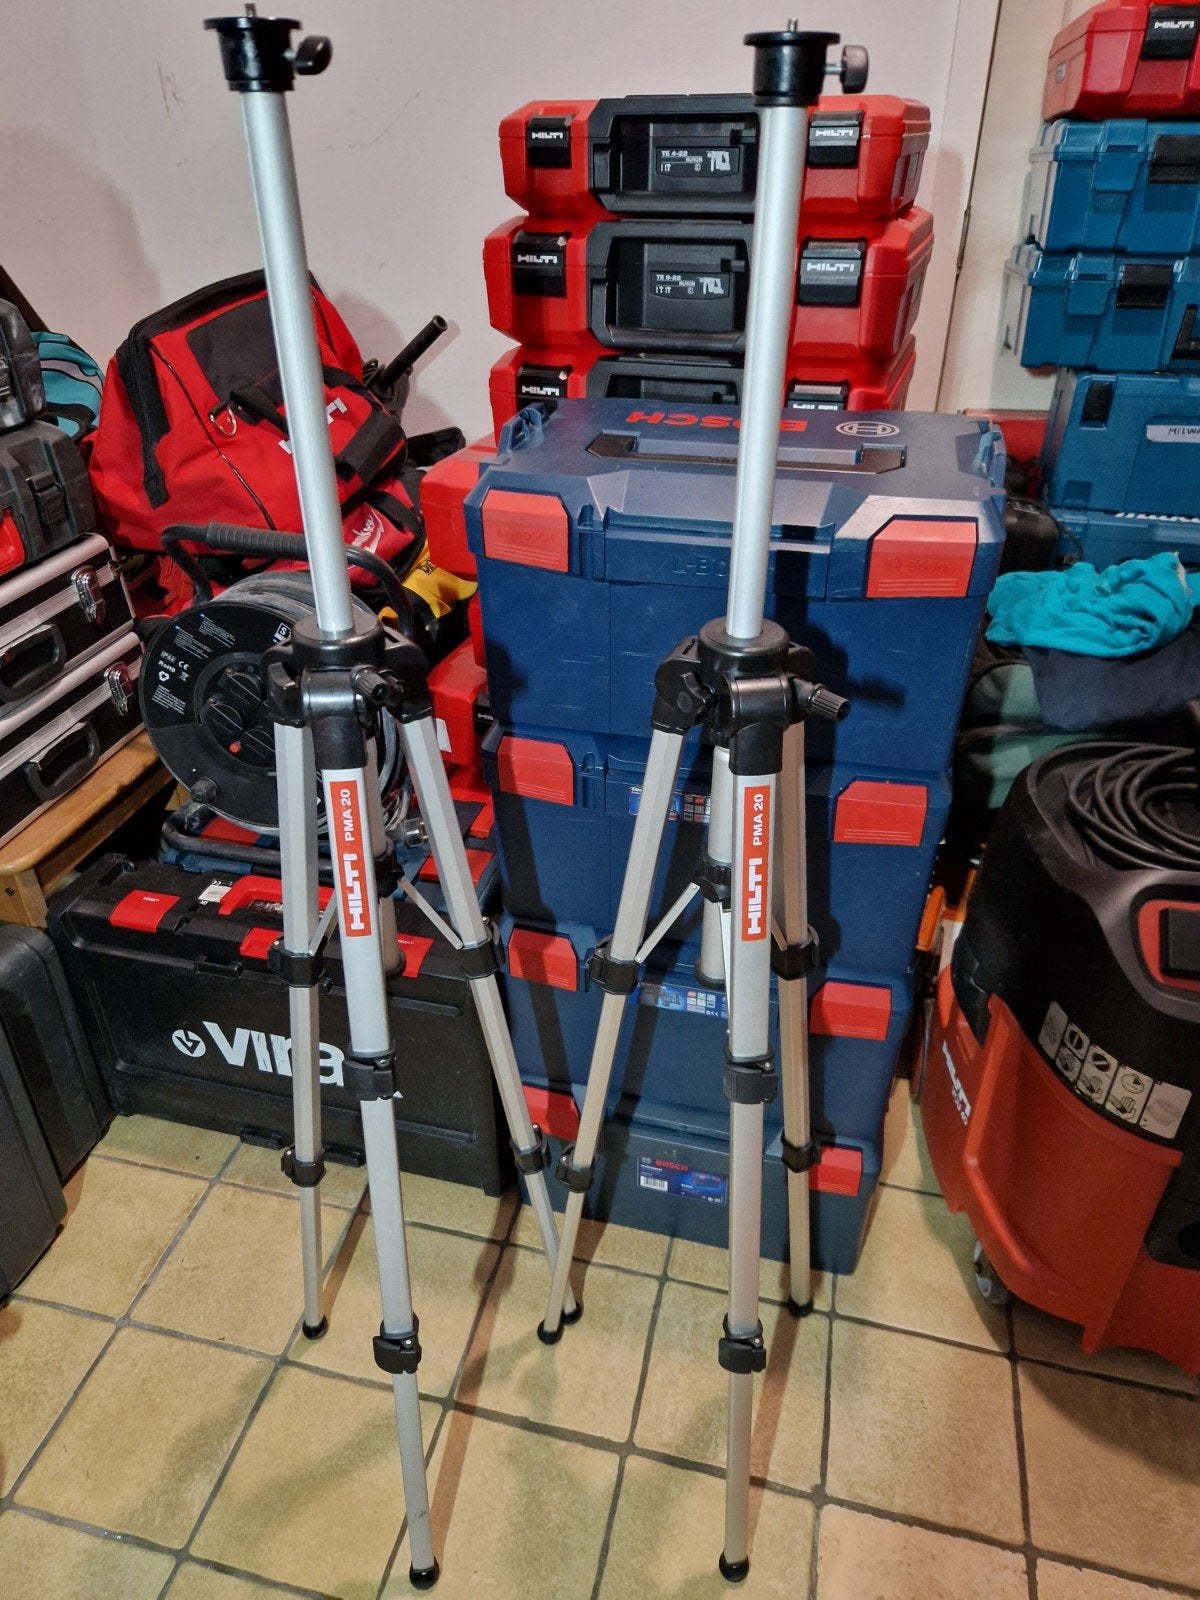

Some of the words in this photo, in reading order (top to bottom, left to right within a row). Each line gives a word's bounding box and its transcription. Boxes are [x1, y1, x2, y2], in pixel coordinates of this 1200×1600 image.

[1154, 20, 1194, 29] HILTI
[531, 131, 563, 139] HILTI
[815, 129, 853, 137] HILTI
[517, 254, 558, 264] HILTI
[806, 262, 855, 272] HILTI
[521, 385, 560, 396] HILTI
[340, 789, 351, 806] 20
[753, 793, 764, 811] 20
[342, 809, 355, 842] PMA
[753, 814, 763, 846] PMA
[343, 853, 365, 930] HILTI
[748, 858, 762, 935] HILTI
[655, 1160, 689, 1171] BOSCH
